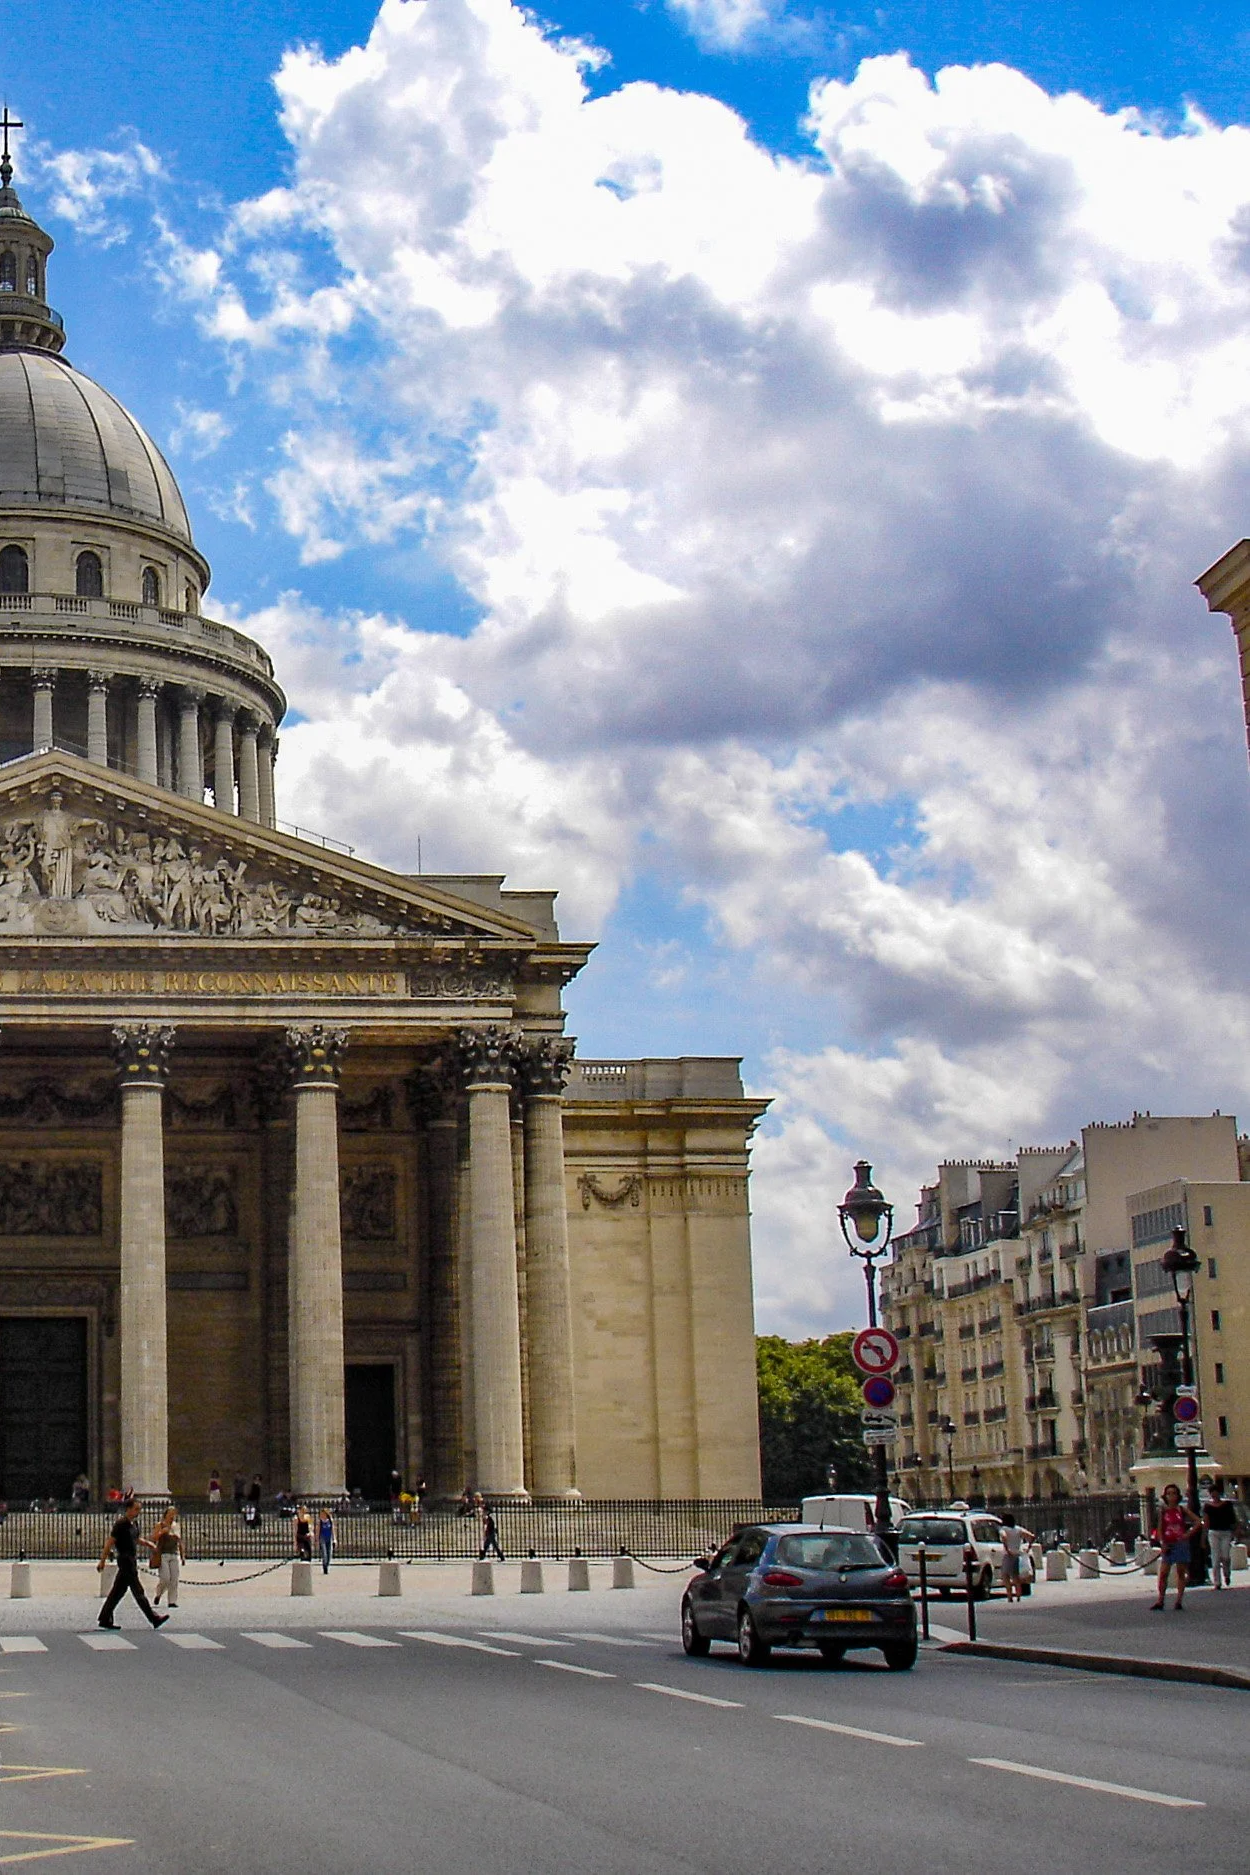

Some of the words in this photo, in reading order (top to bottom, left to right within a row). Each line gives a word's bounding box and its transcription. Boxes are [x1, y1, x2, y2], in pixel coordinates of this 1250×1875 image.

[19, 971, 55, 990] LA
[60, 972, 155, 991] PATRIE
[165, 972, 398, 993] RECONNAISSANTE
